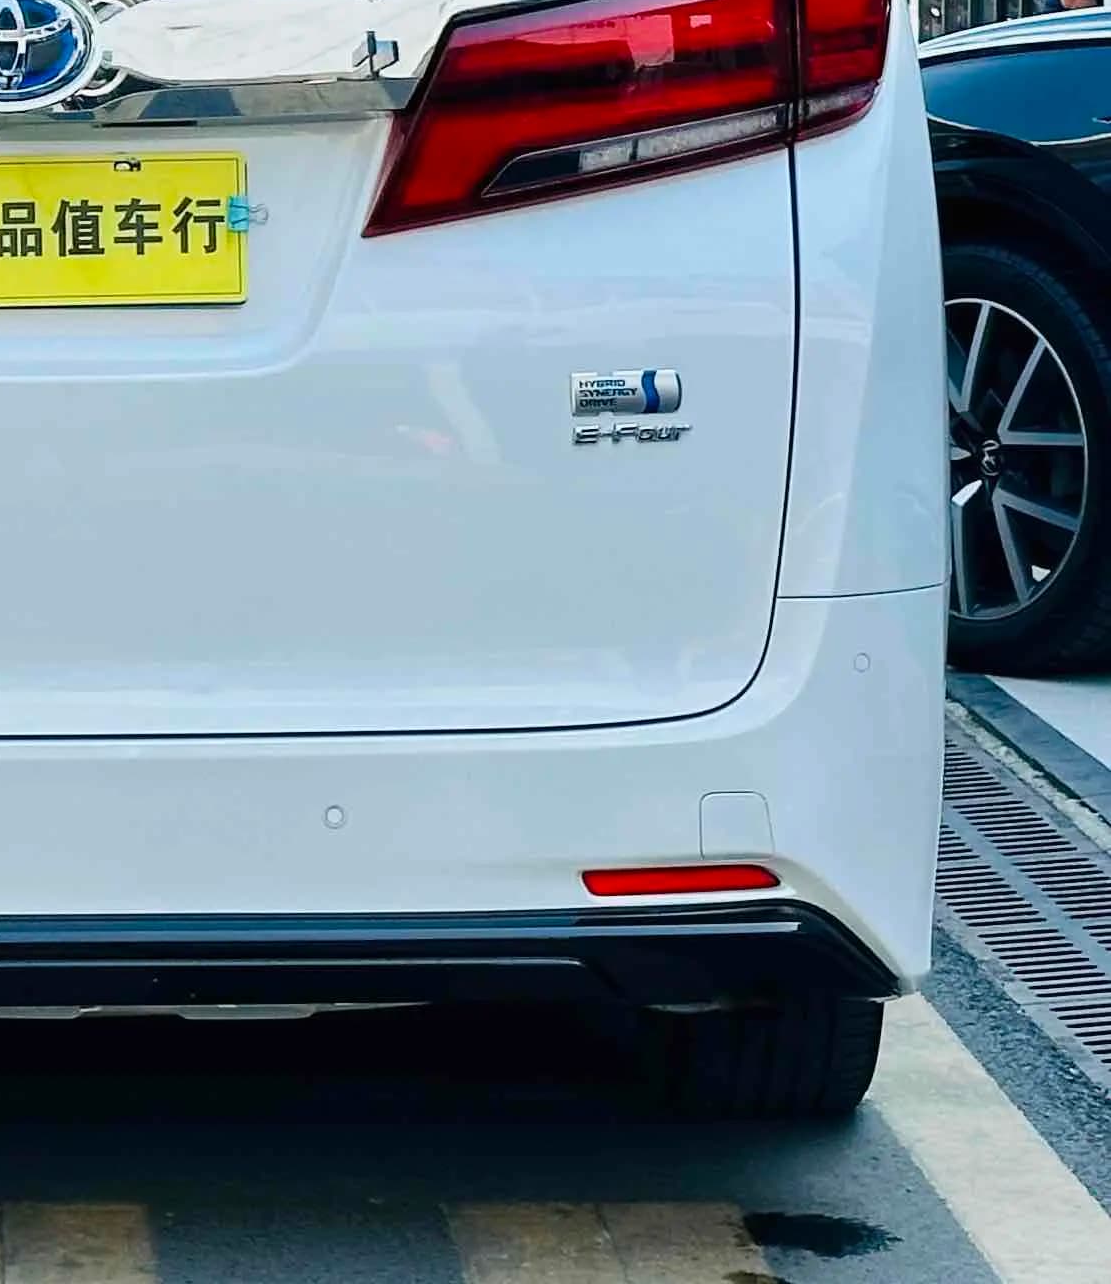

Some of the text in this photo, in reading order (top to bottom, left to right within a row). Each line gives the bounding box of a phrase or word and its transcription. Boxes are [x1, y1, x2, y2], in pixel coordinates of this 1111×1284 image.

[578, 379, 625, 388] HYBRID
[579, 388, 638, 398] SYNERGY
[579, 398, 618, 408] DRIVE
